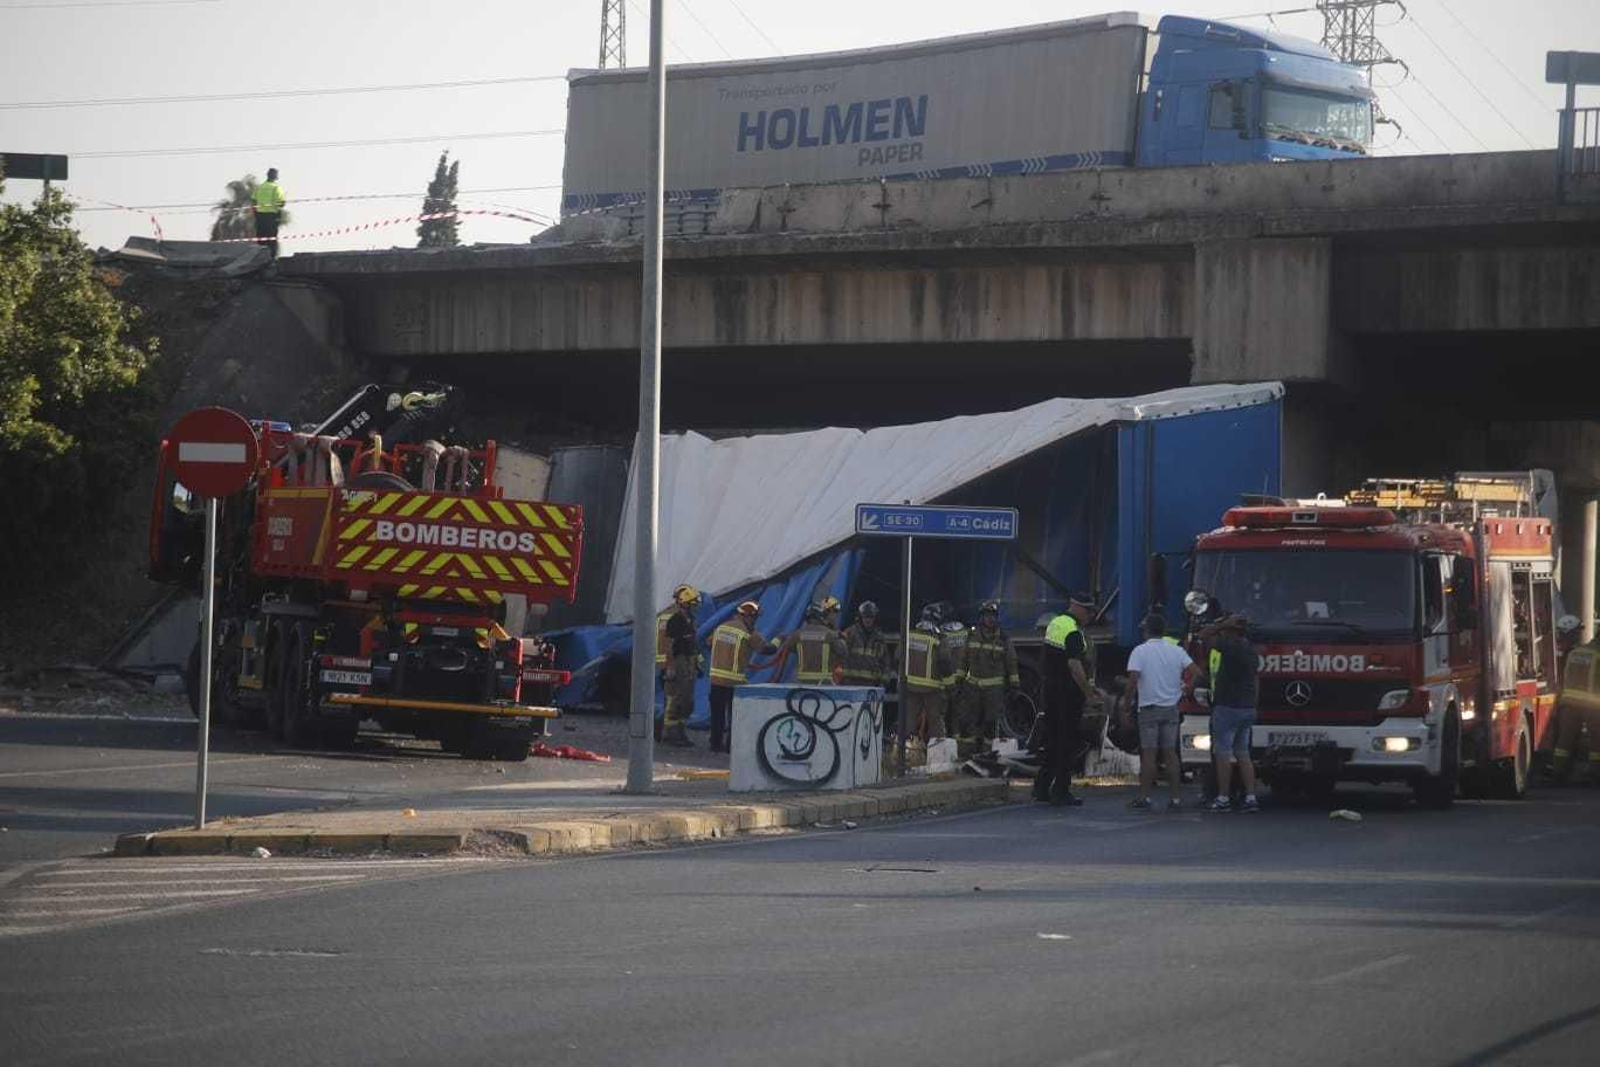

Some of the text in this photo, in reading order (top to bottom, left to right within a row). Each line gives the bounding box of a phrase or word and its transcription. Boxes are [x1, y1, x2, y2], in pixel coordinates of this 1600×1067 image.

[737, 95, 929, 152] HOLMEN
[858, 142, 925, 167] PAPER
[376, 520, 536, 552] BOMBEROS
